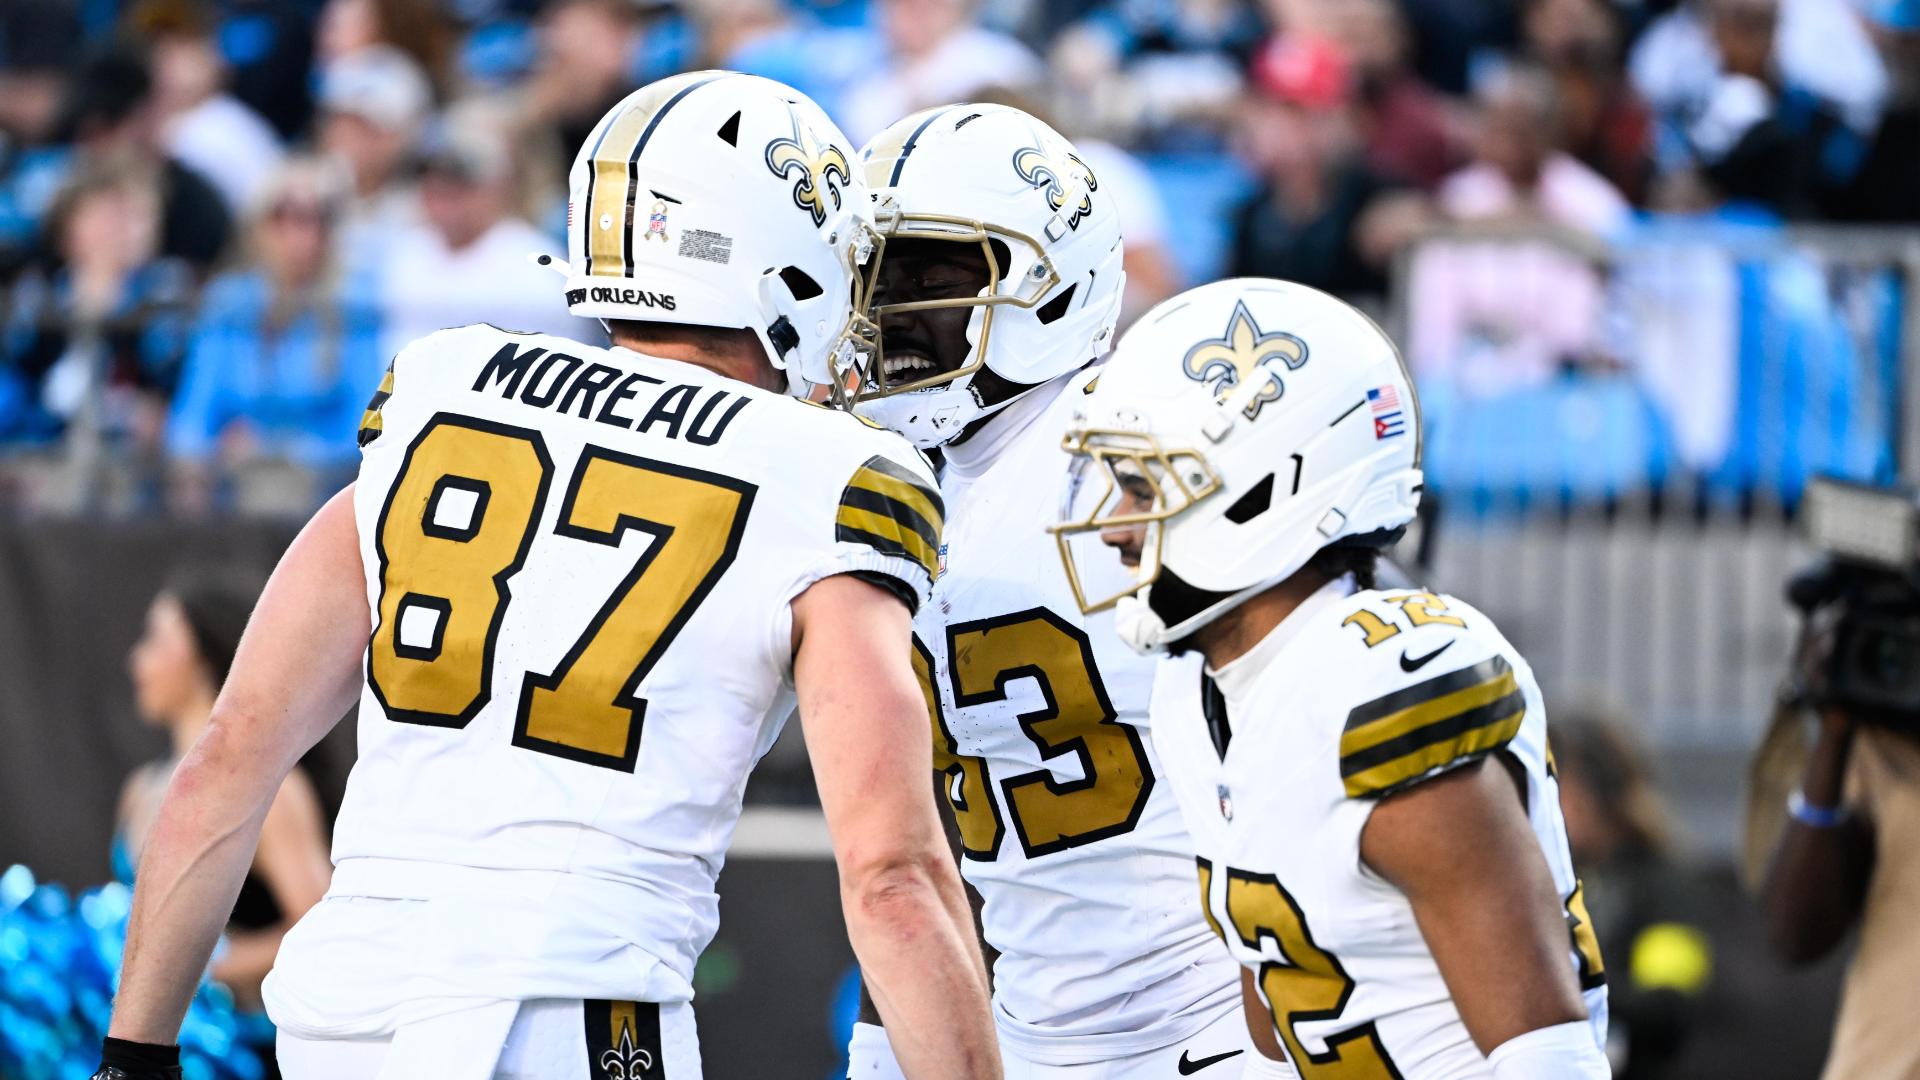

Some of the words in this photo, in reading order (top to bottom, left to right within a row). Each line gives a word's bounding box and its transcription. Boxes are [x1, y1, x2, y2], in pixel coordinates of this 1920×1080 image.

[590, 287, 676, 311] ORLEANS
[472, 342, 753, 446] MOREAU
[367, 411, 759, 774] 87
[1341, 592, 1468, 648] 12
[1196, 855, 1404, 1080] 2
